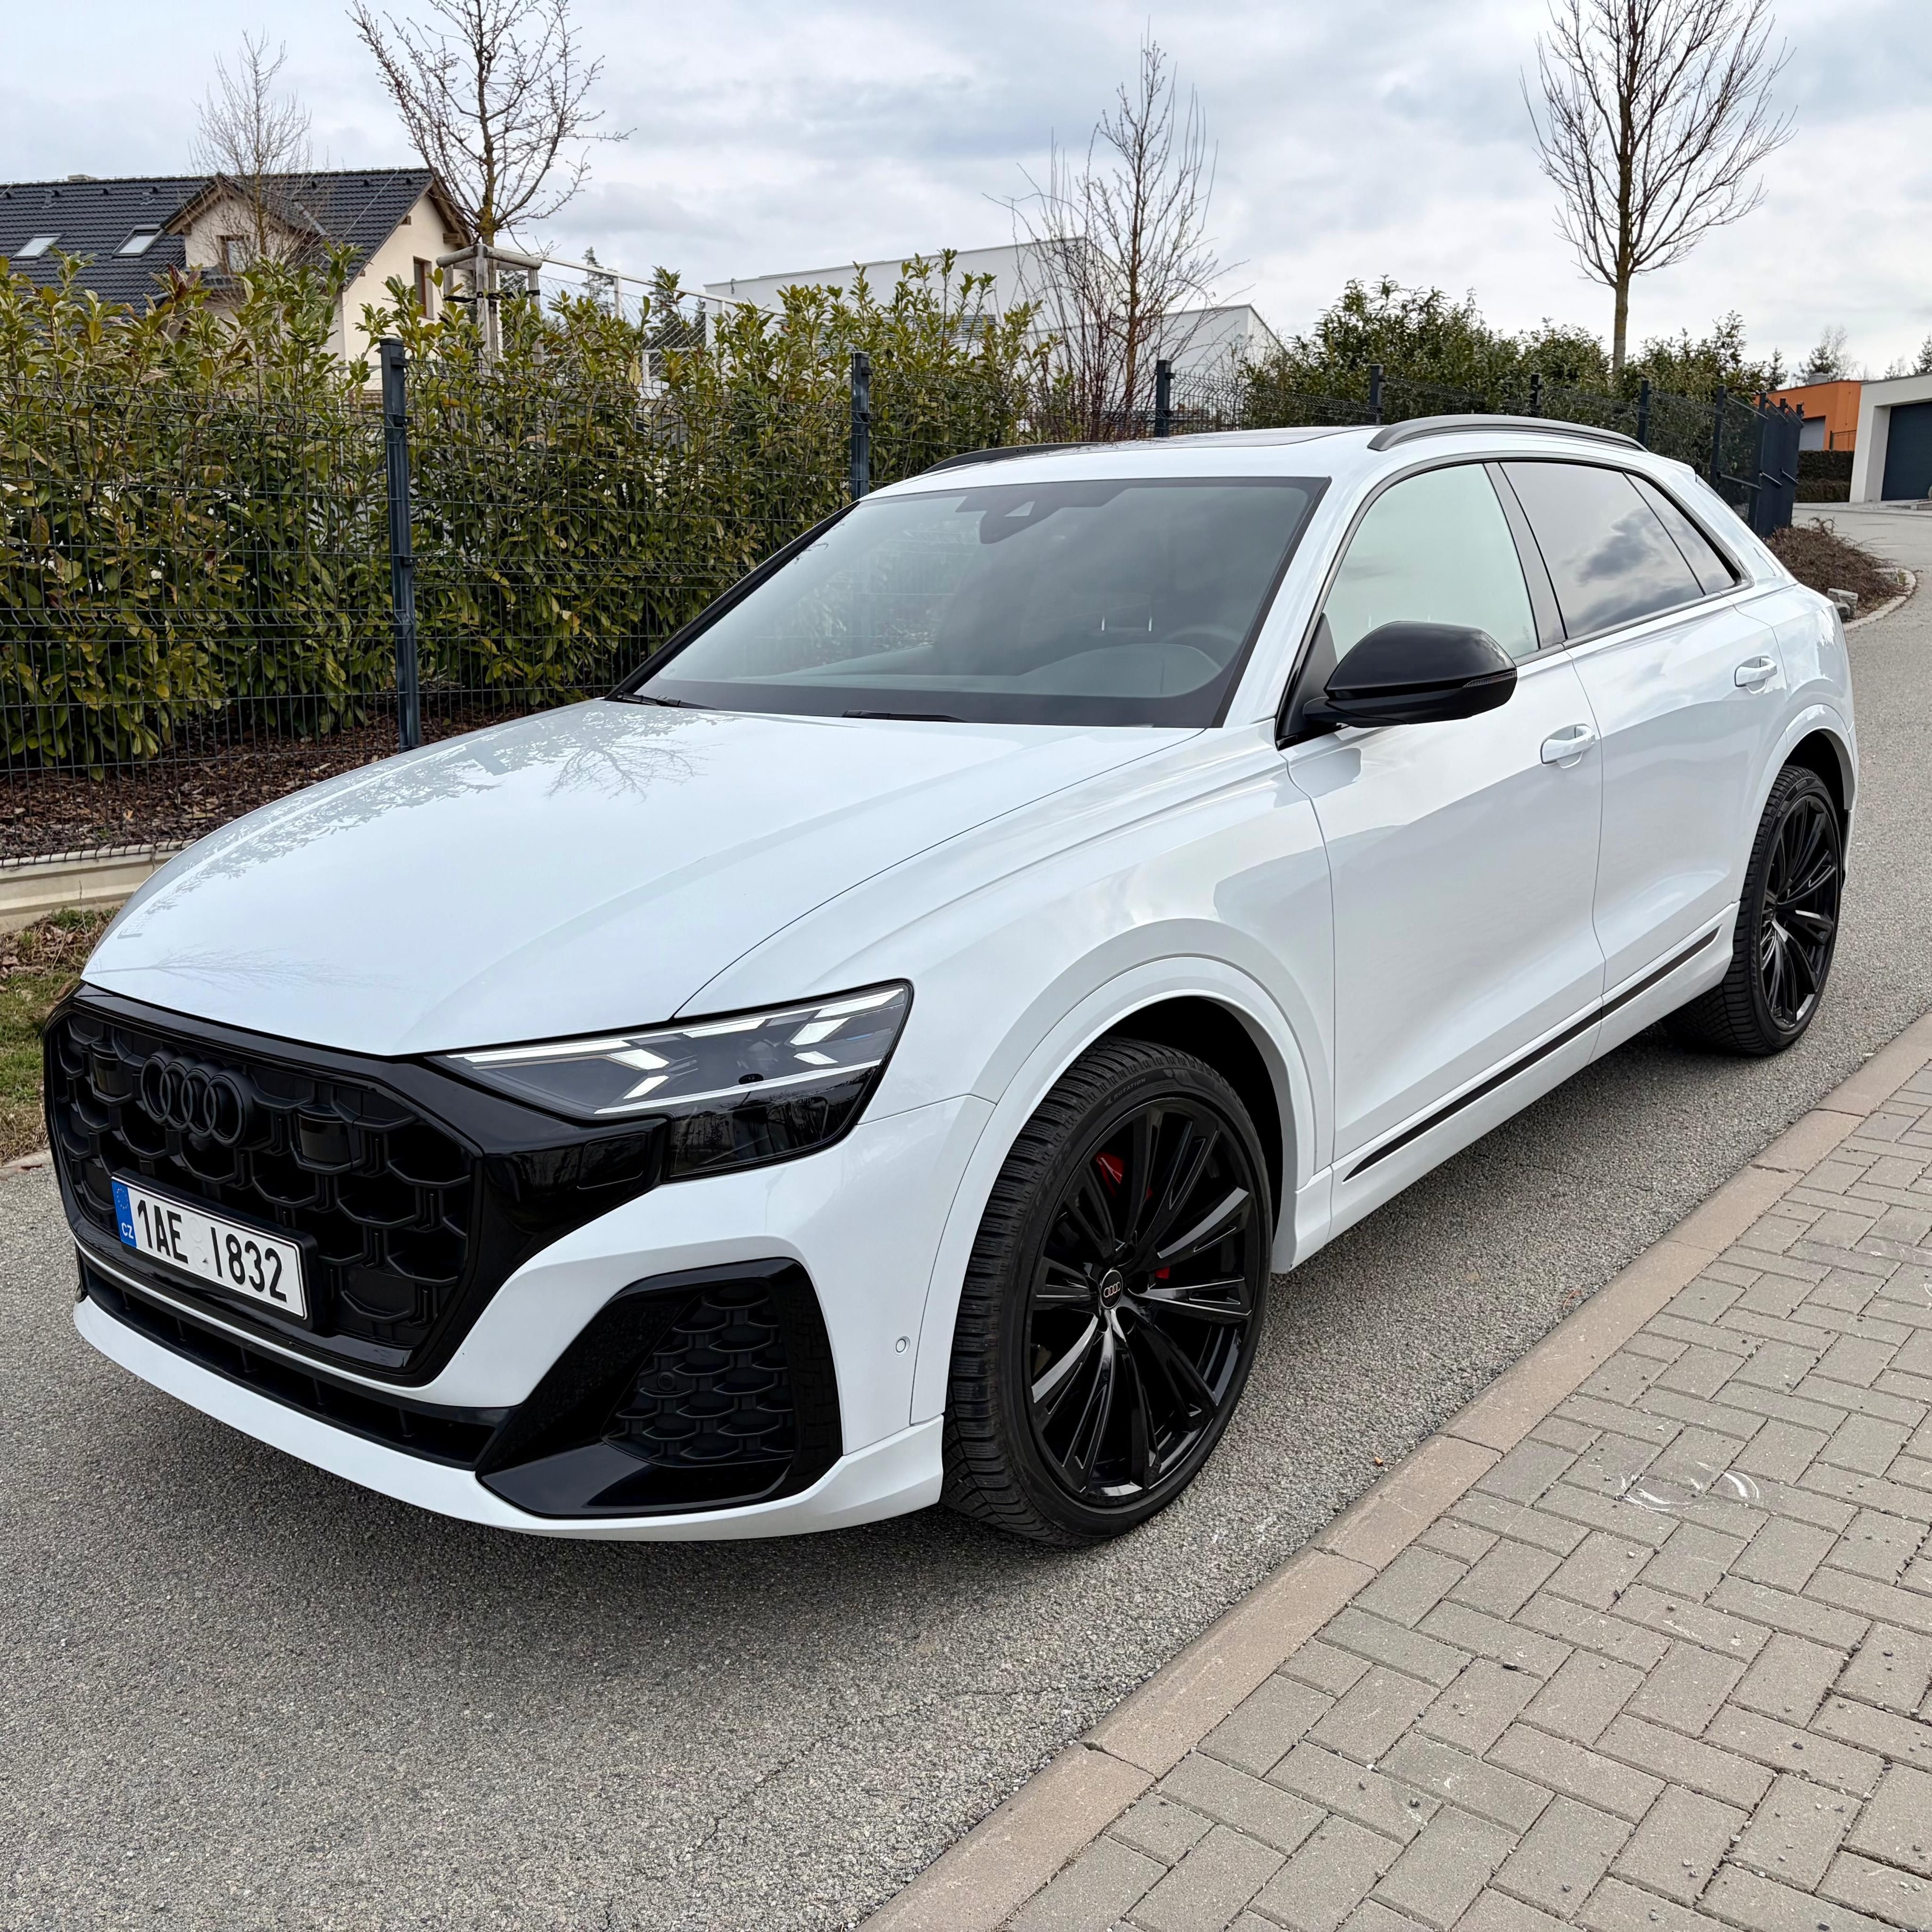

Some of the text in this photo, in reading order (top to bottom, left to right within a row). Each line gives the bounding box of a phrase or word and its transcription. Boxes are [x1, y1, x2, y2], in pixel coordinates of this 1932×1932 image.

[1114, 1077, 1146, 1099] ROTATION
[121, 1222, 134, 1240] CZ
[137, 1199, 189, 1265] 1AE
